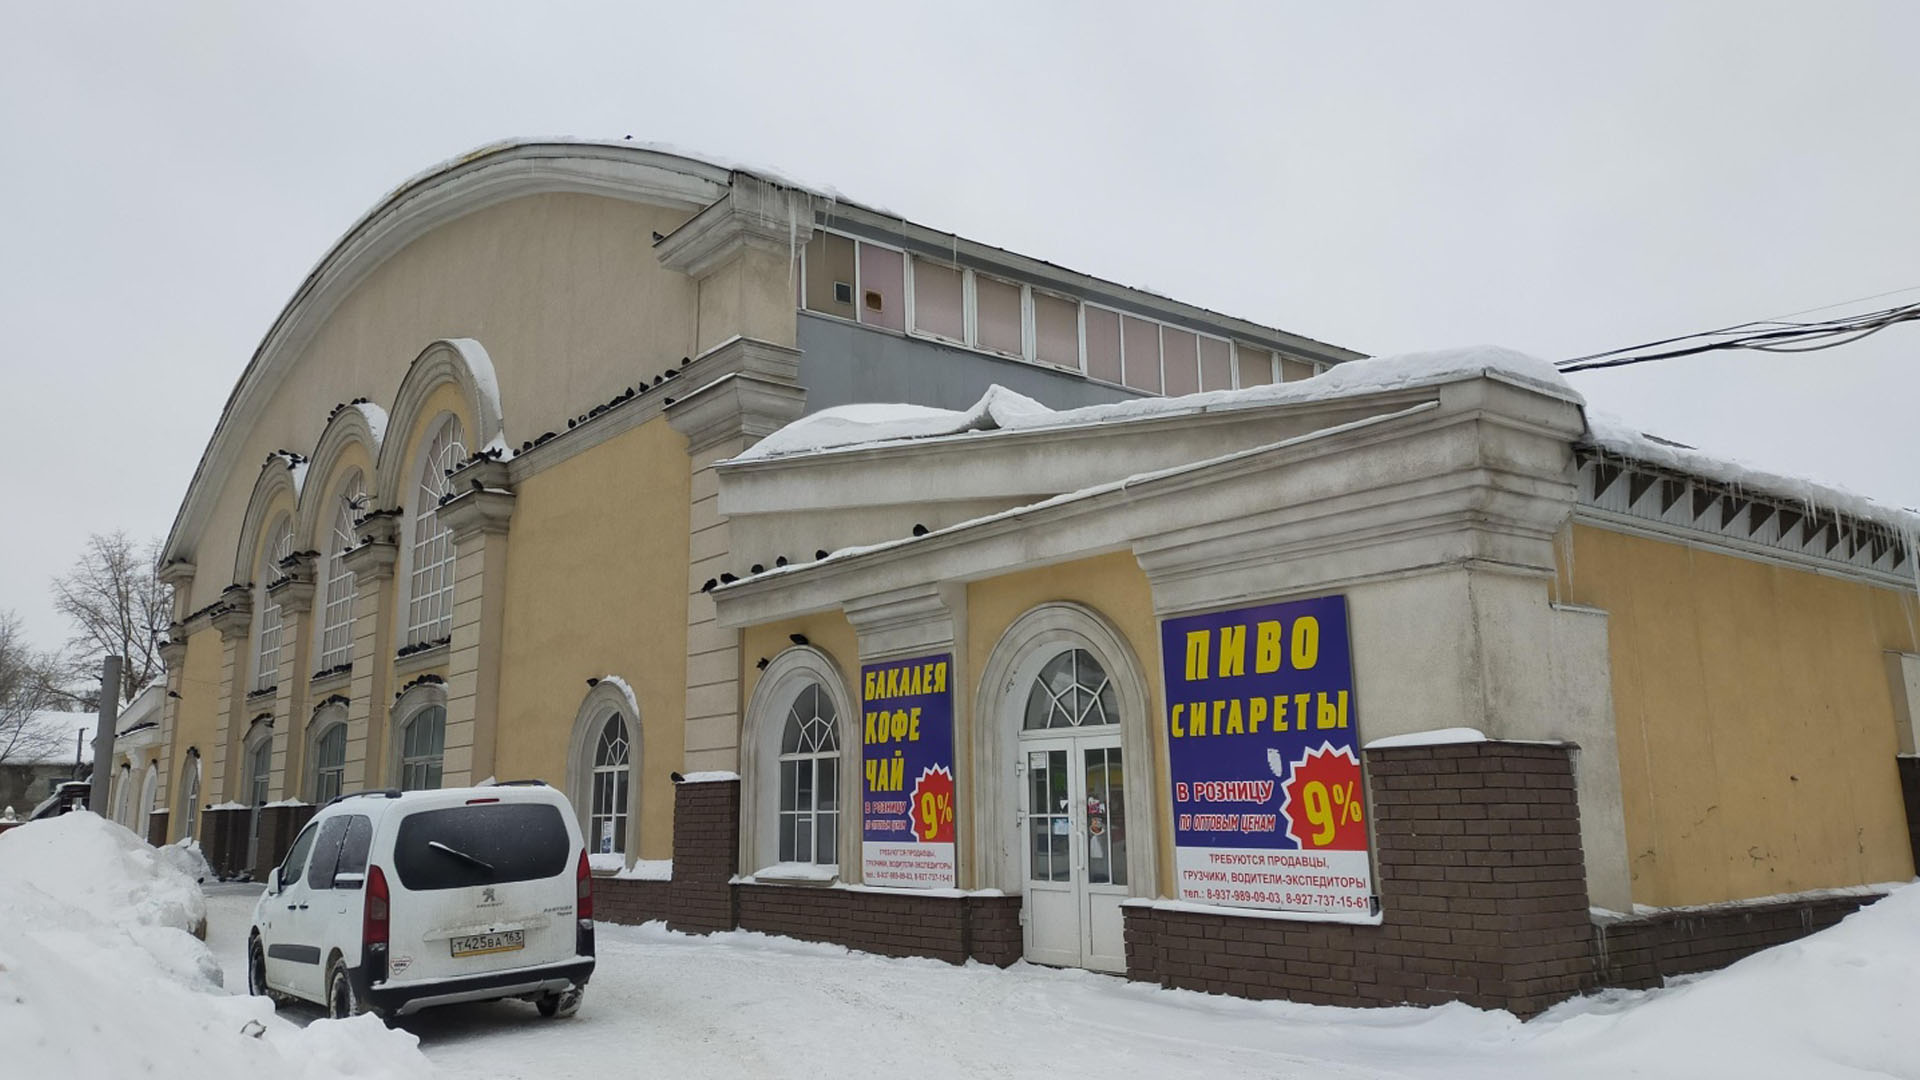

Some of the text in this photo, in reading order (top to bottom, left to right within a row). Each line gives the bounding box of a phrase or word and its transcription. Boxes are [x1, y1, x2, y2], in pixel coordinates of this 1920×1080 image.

[1185, 616, 1320, 681] ПИВО
[865, 662, 947, 700] БАКАЛЕЯ
[865, 707, 921, 744] КОФЕ
[1171, 690, 1349, 738] СИГАРЕТЫ
[866, 750, 904, 791] ЧАЙ
[1176, 780, 1274, 804] В РОЗНИЦУ
[864, 800, 907, 816] В РОЗНИЦУ
[921, 792, 953, 839] 9%
[1302, 780, 1362, 846] 9%
[1179, 814, 1276, 834] ПО ОПТОВЫМ ЦЕНАМ
[1209, 853, 1330, 869] ТРЕБУЮТСЯ ПРОДАВЦЫ,
[1183, 870, 1366, 889] ГРУЗЧИКИ, ВОДИТЕЛИ-ЭКСПЕДИТОРЫ
[1285, 893, 1369, 909] 8-927-737-15-61
[457, 932, 521, 951] Т425ВА 163
